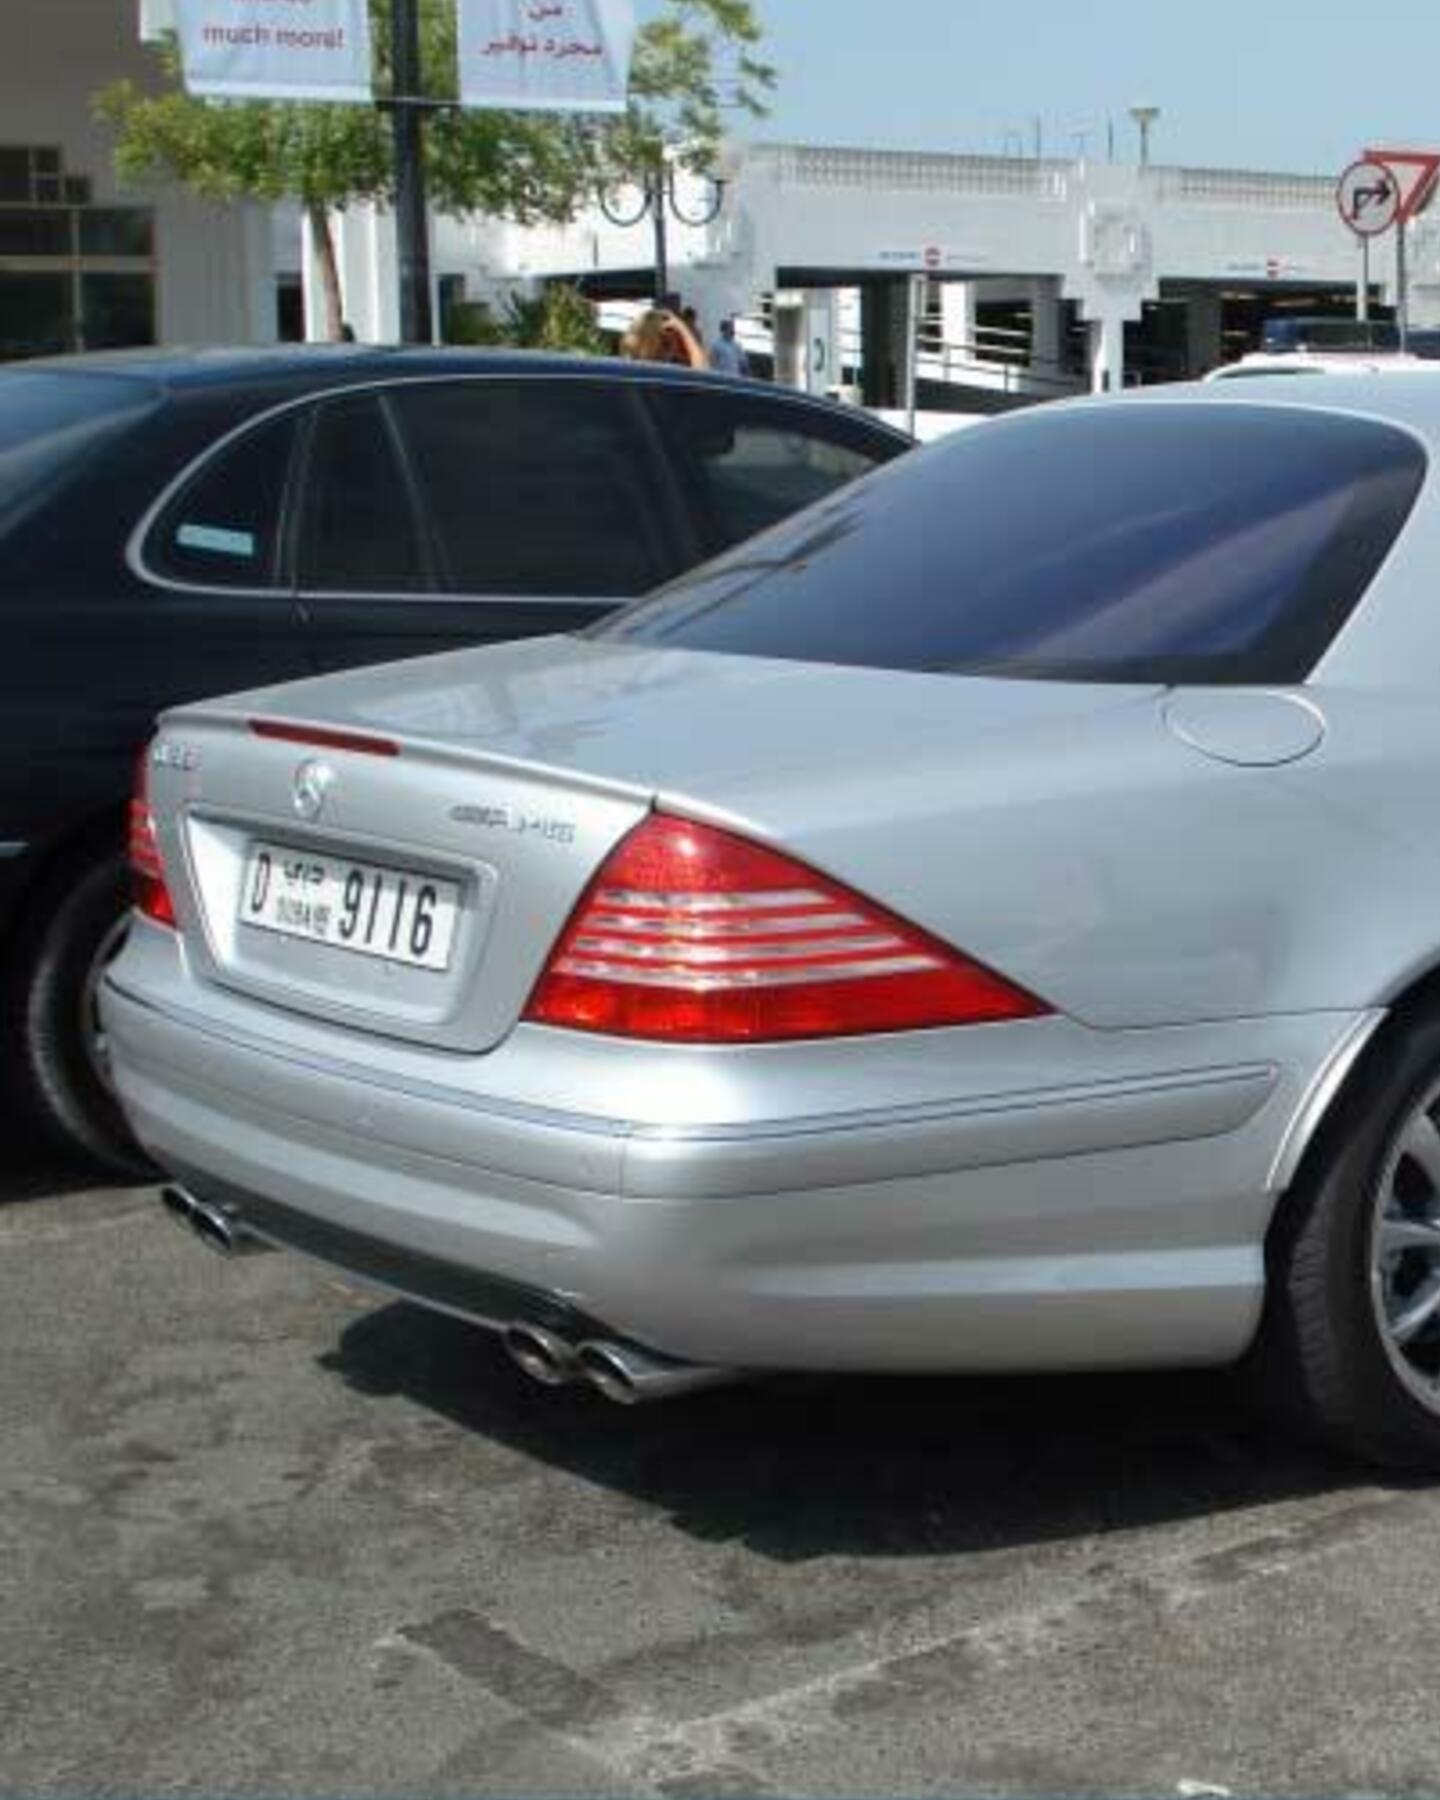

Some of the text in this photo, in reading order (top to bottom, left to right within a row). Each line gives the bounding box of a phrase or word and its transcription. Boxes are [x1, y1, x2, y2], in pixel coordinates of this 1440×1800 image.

[203, 24, 345, 49] much more!
[252, 852, 271, 914] D
[338, 869, 437, 957] 9116
